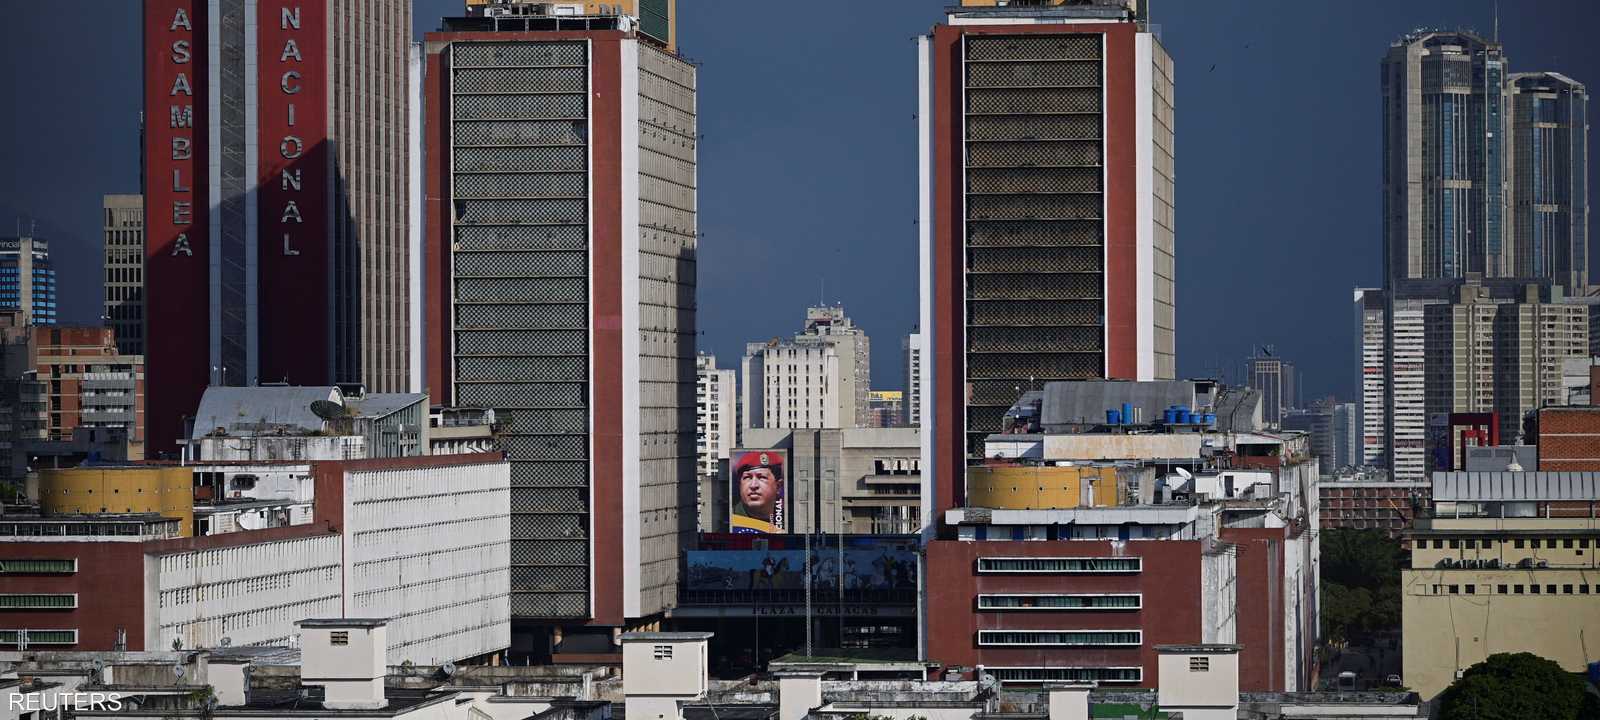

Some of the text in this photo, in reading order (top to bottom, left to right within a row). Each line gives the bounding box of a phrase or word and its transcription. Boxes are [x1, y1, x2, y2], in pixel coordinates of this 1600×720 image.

[170, 8, 193, 256] ASAMBLEA
[280, 7, 303, 256] NACIONAL
[752, 607, 795, 615] PLAZA
